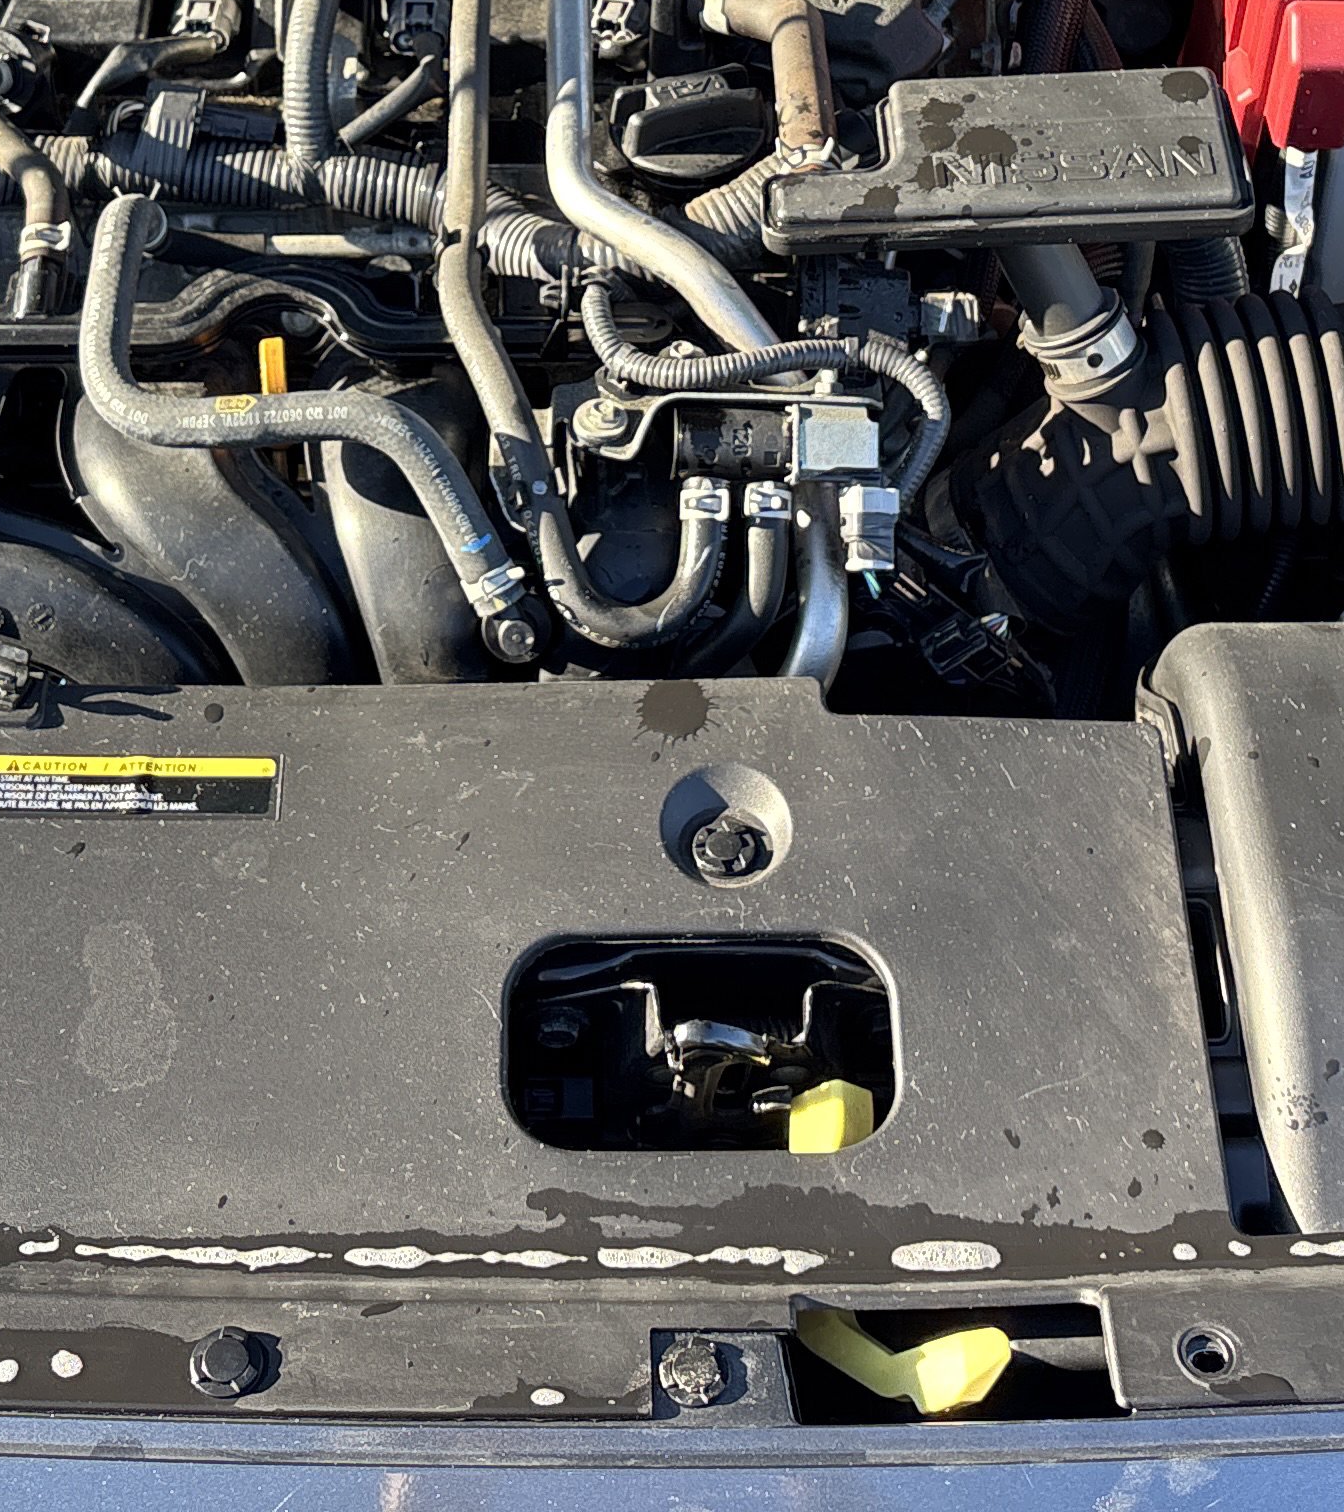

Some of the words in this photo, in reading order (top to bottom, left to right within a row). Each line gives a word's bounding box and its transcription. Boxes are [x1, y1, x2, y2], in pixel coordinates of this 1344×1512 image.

[931, 143, 1216, 188] NISSAN
[22, 762, 88, 772] CAUTION
[119, 762, 197, 772] ATTENTION
[1, 774, 22, 782] START
[33, 775, 51, 783] ANY
[64, 783, 83, 791] KEEP
[83, 783, 110, 792] HANDS
[4, 791, 34, 800] RISQUE
[35, 791, 47, 800] DE
[102, 792, 124, 800] TOUT
[61, 800, 73, 809] NE
[74, 801, 90, 809] PAS
[91, 801, 103, 809] EN
[153, 802, 168, 810] LES
